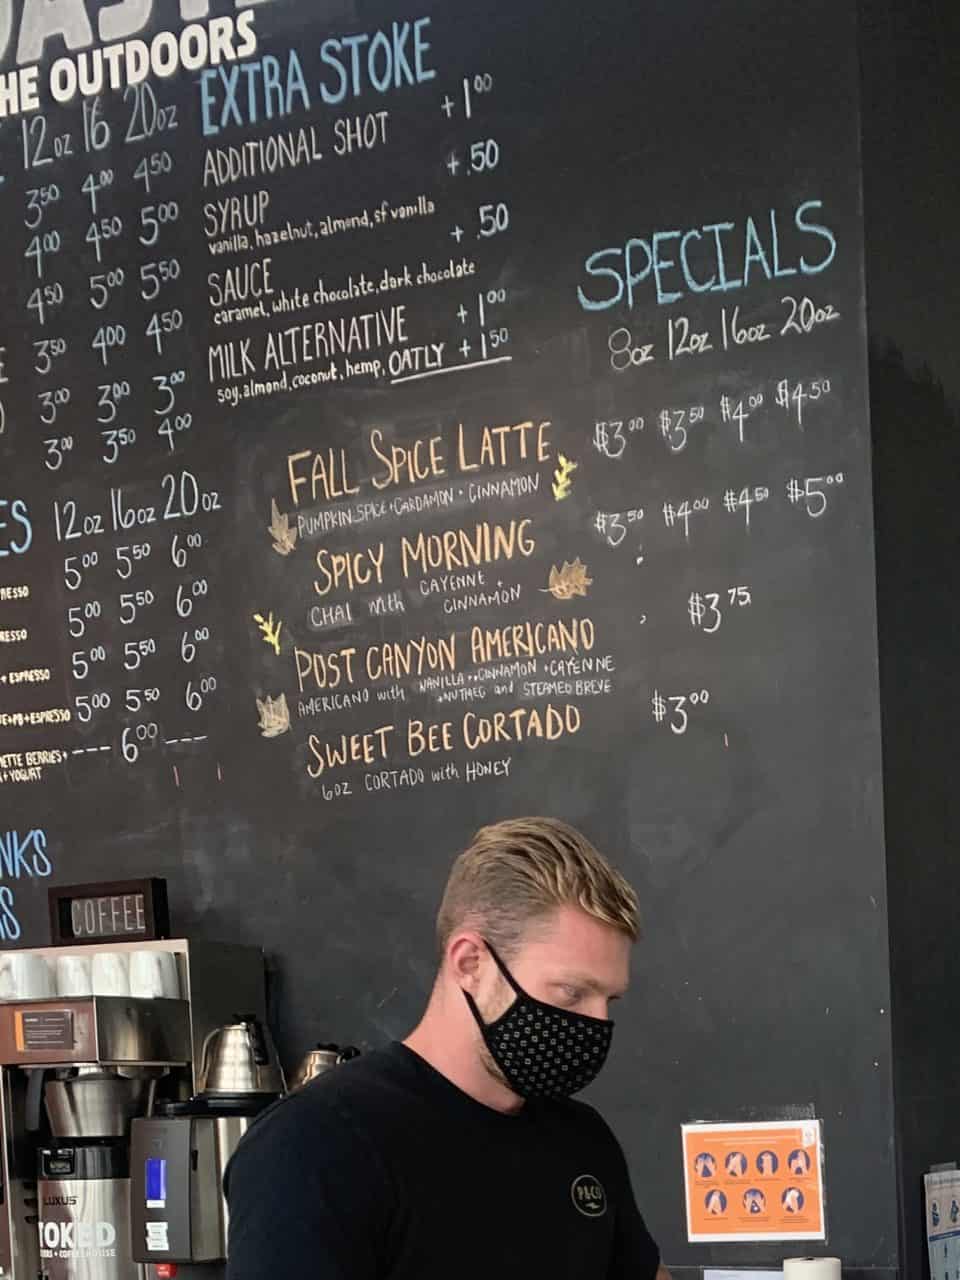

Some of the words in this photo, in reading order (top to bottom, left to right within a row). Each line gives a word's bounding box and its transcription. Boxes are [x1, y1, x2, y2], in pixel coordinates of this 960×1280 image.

[50, 10, 257, 102] OUTDOORS
[201, 49, 310, 136] EXTRA
[319, 16, 436, 104] STOKE
[203, 126, 322, 187] ADDITIONAL
[333, 111, 388, 155] SHOT
[203, 190, 270, 237] SYRUP
[390, 196, 435, 219] vanilla
[207, 258, 274, 307] SAUCE
[577, 200, 837, 311] SPECIALS
[272, 289, 309, 314] white
[416, 256, 476, 286] chocolate
[208, 339, 256, 383] MILK
[264, 305, 409, 371] ALTERNATIVE
[388, 342, 445, 376] OATLY
[287, 448, 360, 506] FALL
[370, 429, 446, 491] SPICE
[458, 421, 552, 472] LATTE
[296, 509, 352, 538] PUMPKIN
[468, 472, 539, 503] CINNAMON
[314, 543, 384, 596] SPICY
[401, 519, 536, 578] MORNING
[310, 602, 352, 628] CHAI
[419, 570, 485, 595] CAYENNE
[443, 584, 521, 614] CINNAMON
[9, 668, 51, 685] ESPRESSO
[294, 646, 356, 692] POST
[366, 634, 456, 680] CANYON
[471, 618, 595, 663] AMERICANO
[298, 688, 369, 717] AMERICANO
[307, 724, 395, 778] SWEET
[407, 718, 453, 756] BEE
[463, 704, 581, 750] CORTADO
[364, 768, 424, 792] CORTADO
[465, 757, 512, 782] HONEY
[0, 886, 20, 939] S
[71, 894, 146, 934] COFFEE
